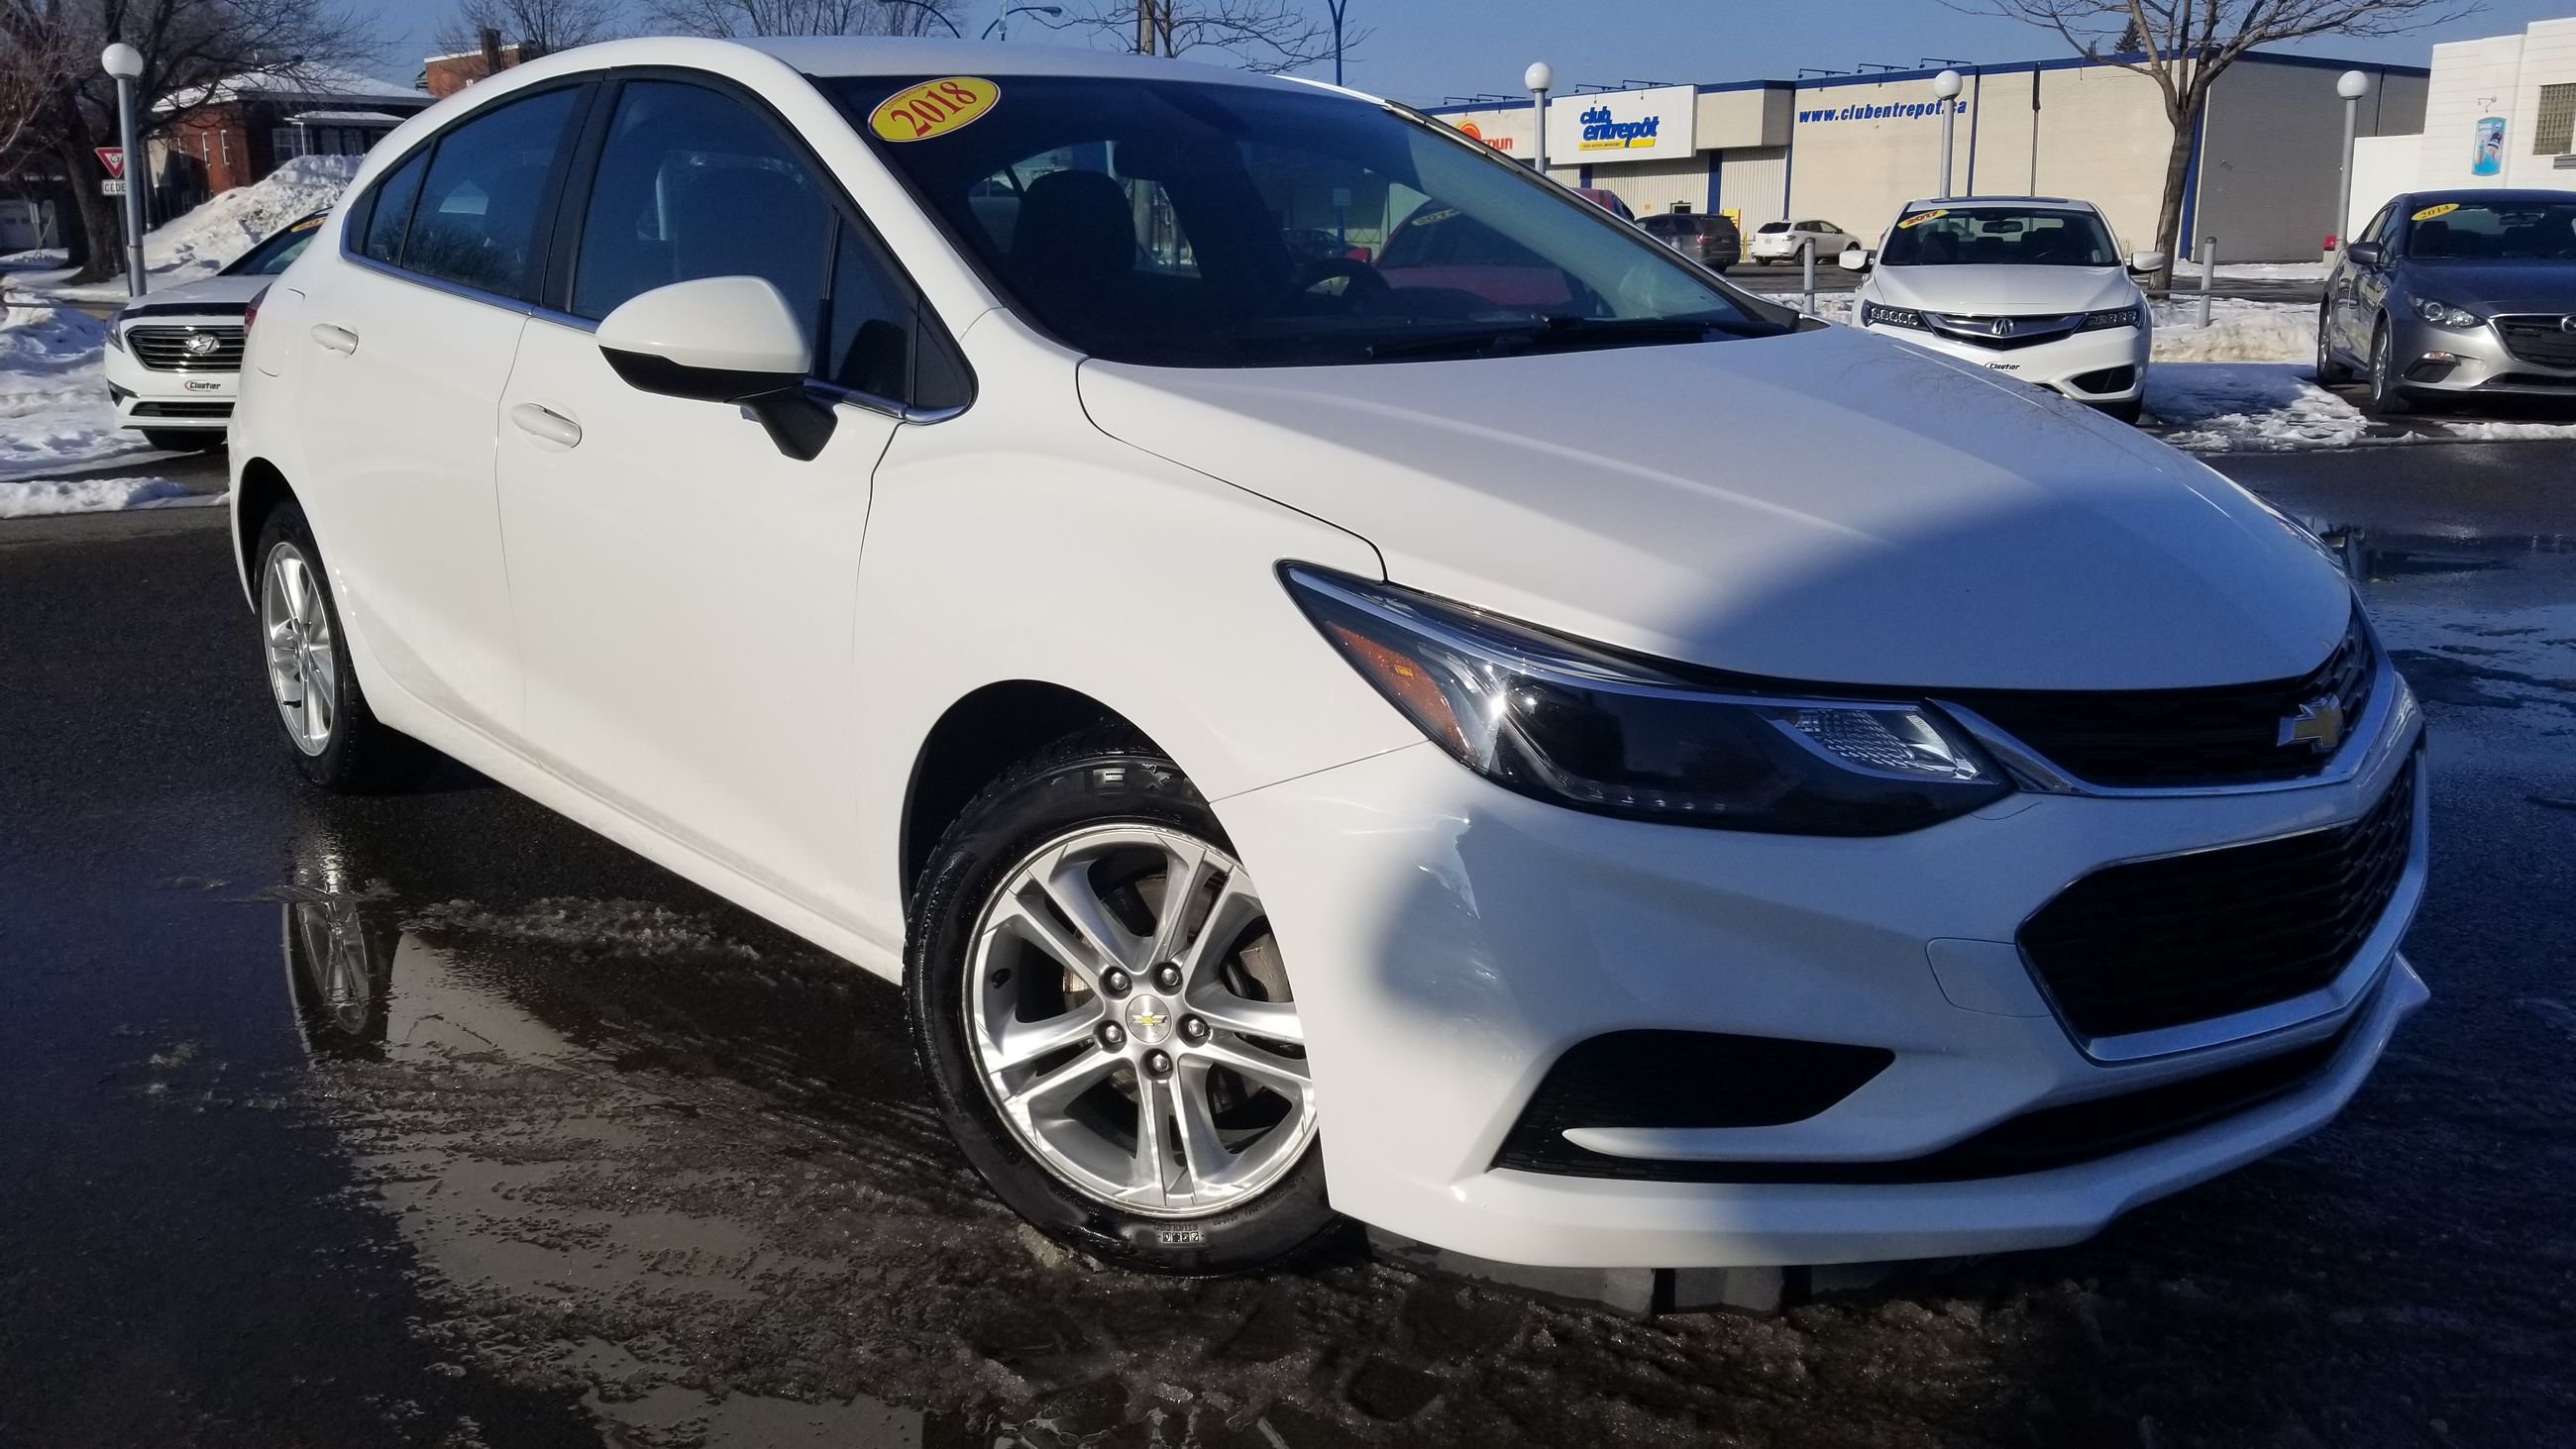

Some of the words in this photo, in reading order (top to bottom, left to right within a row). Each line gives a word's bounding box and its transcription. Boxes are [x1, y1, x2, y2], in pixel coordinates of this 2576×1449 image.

[891, 80, 978, 137] 2018
[1580, 106, 1612, 125] club
[1799, 100, 1967, 123] www.clubentrepot.a
[1583, 116, 1660, 148] entrepôt
[104, 182, 126, 192] CEDE
